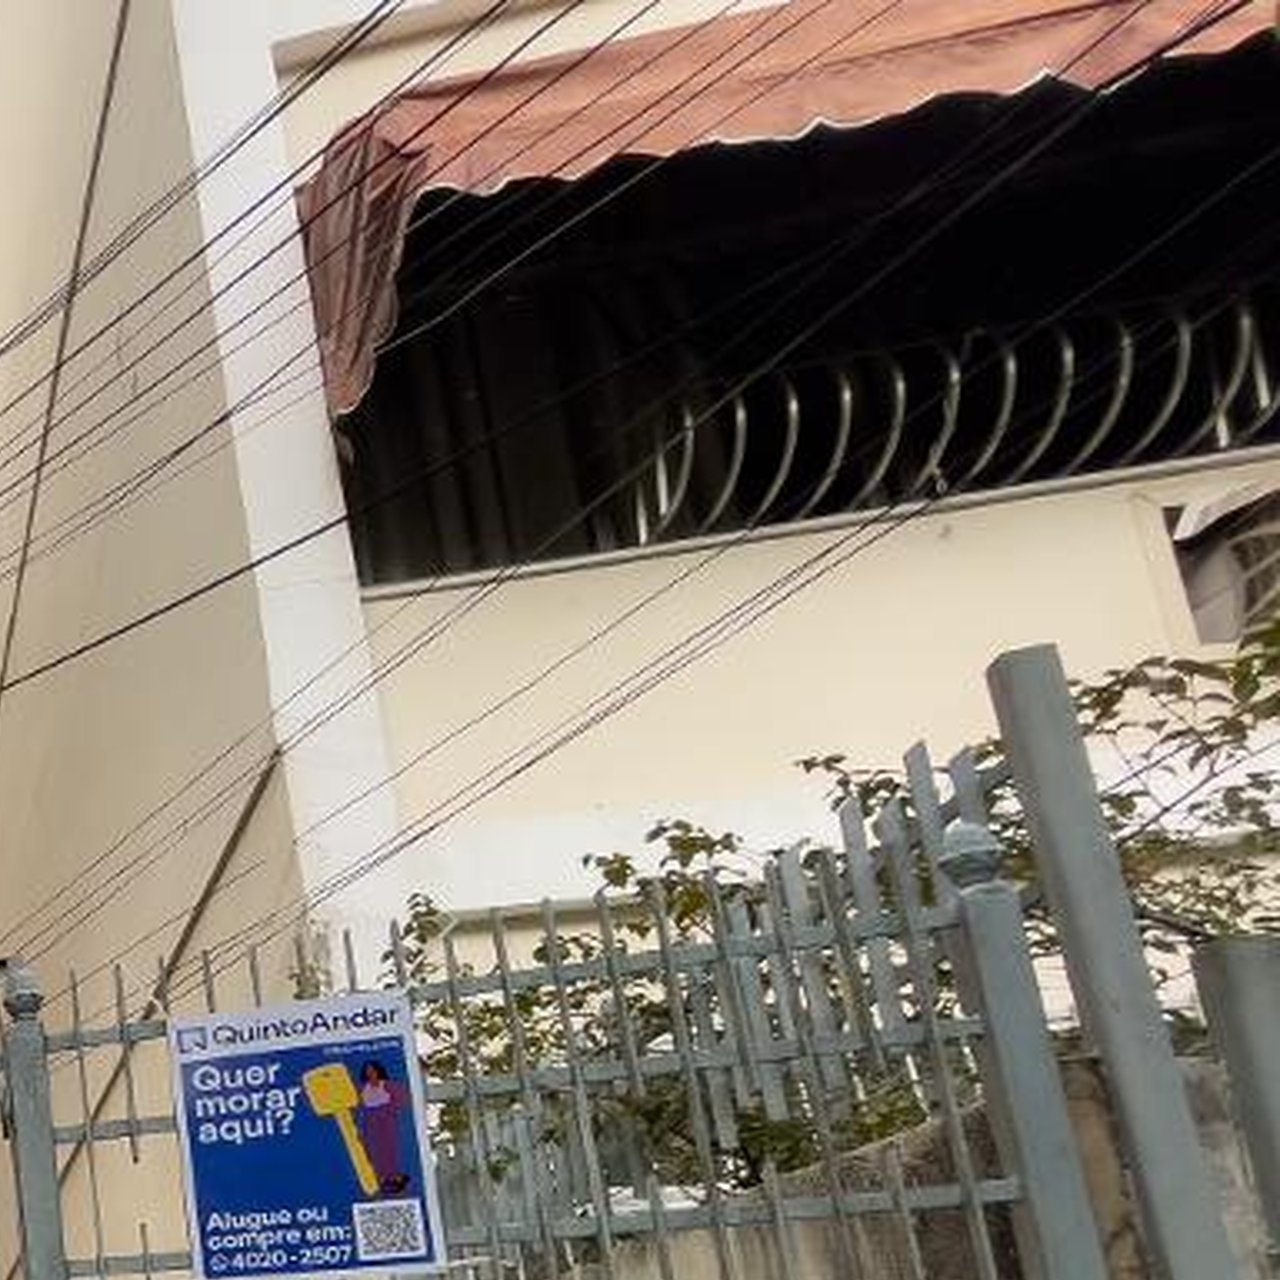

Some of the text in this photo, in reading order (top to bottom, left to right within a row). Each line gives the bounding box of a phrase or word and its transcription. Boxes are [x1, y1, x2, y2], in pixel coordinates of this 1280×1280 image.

[212, 1006, 398, 1046] QuintoAndar
[193, 1062, 280, 1091] Quer
[195, 1087, 301, 1117] morar
[198, 1111, 294, 1144] aqui?
[206, 1206, 328, 1233] Alugue ou
[207, 1225, 352, 1250] compre em:
